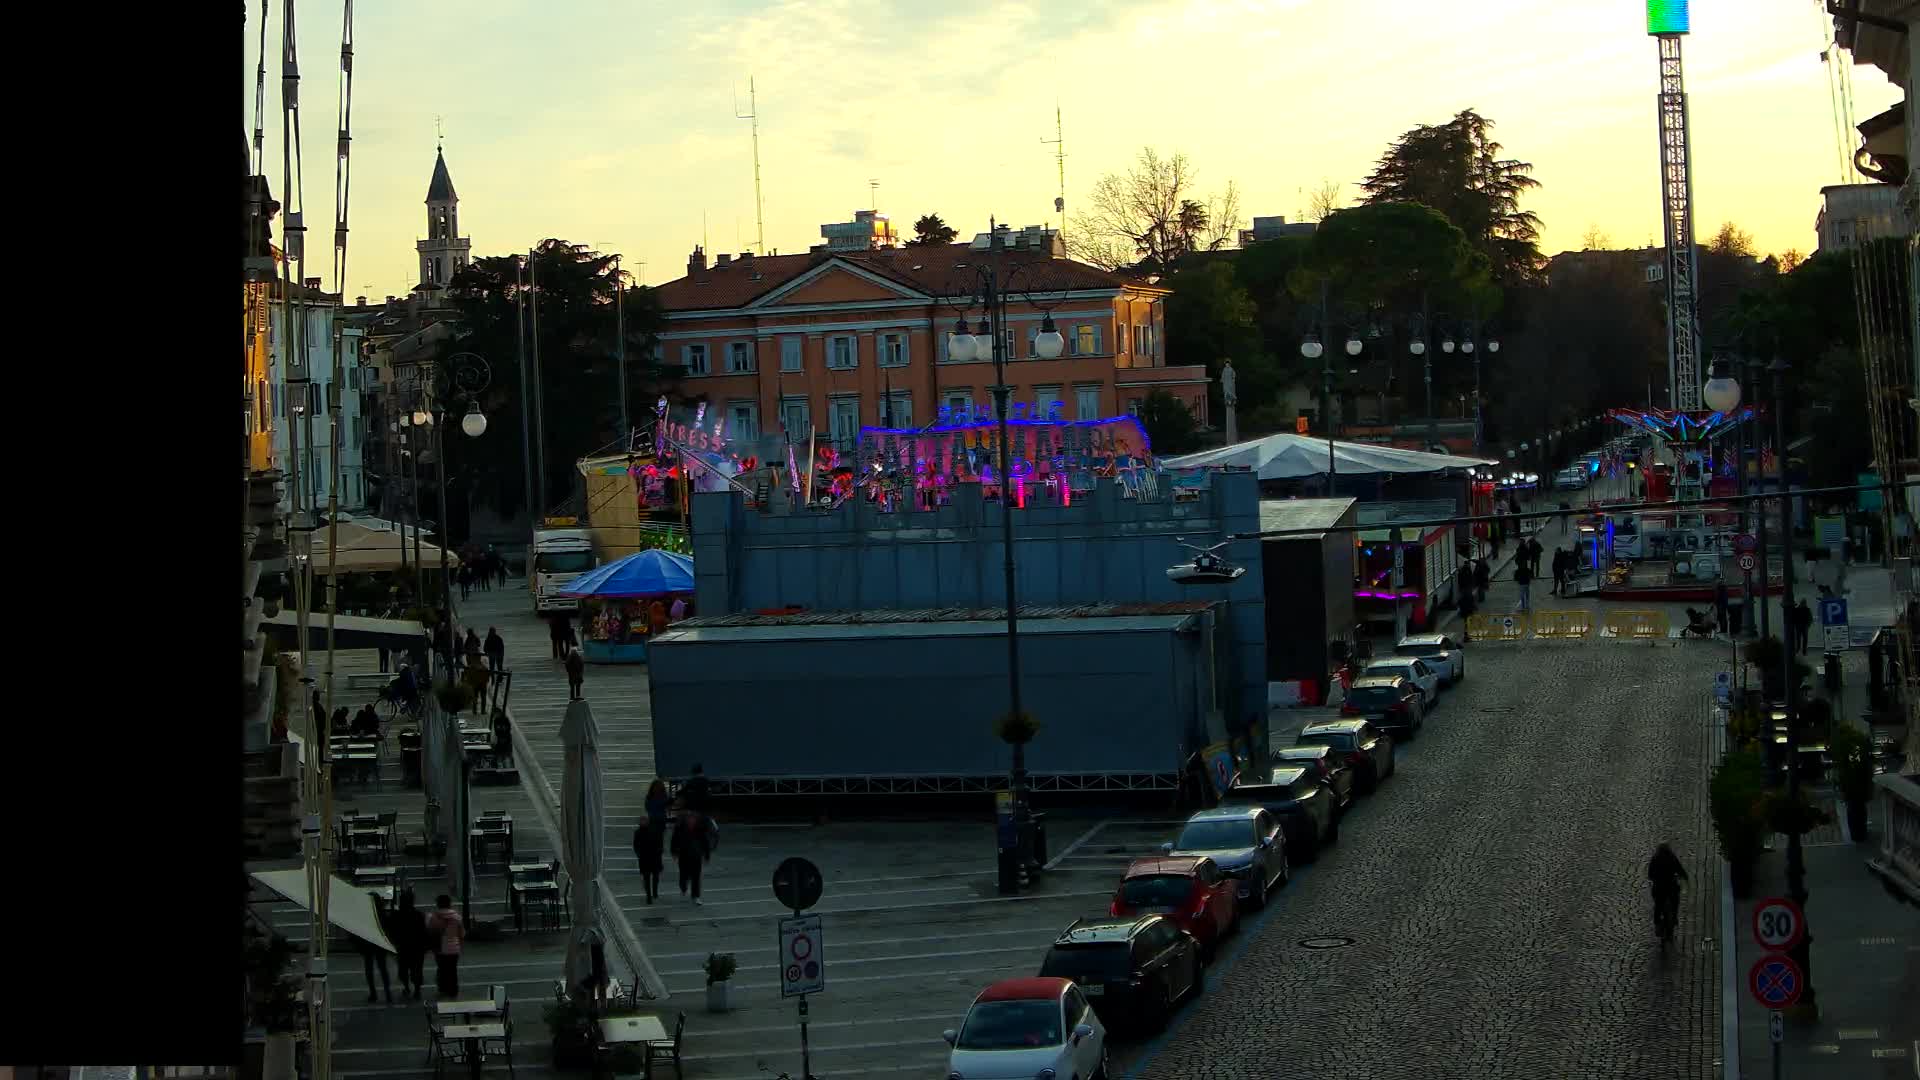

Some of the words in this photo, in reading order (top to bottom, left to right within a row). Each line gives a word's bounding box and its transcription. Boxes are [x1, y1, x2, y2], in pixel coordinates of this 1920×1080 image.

[1742, 558, 1753, 568] 20
[1826, 603, 1841, 624] P
[1761, 911, 1791, 938] 30
